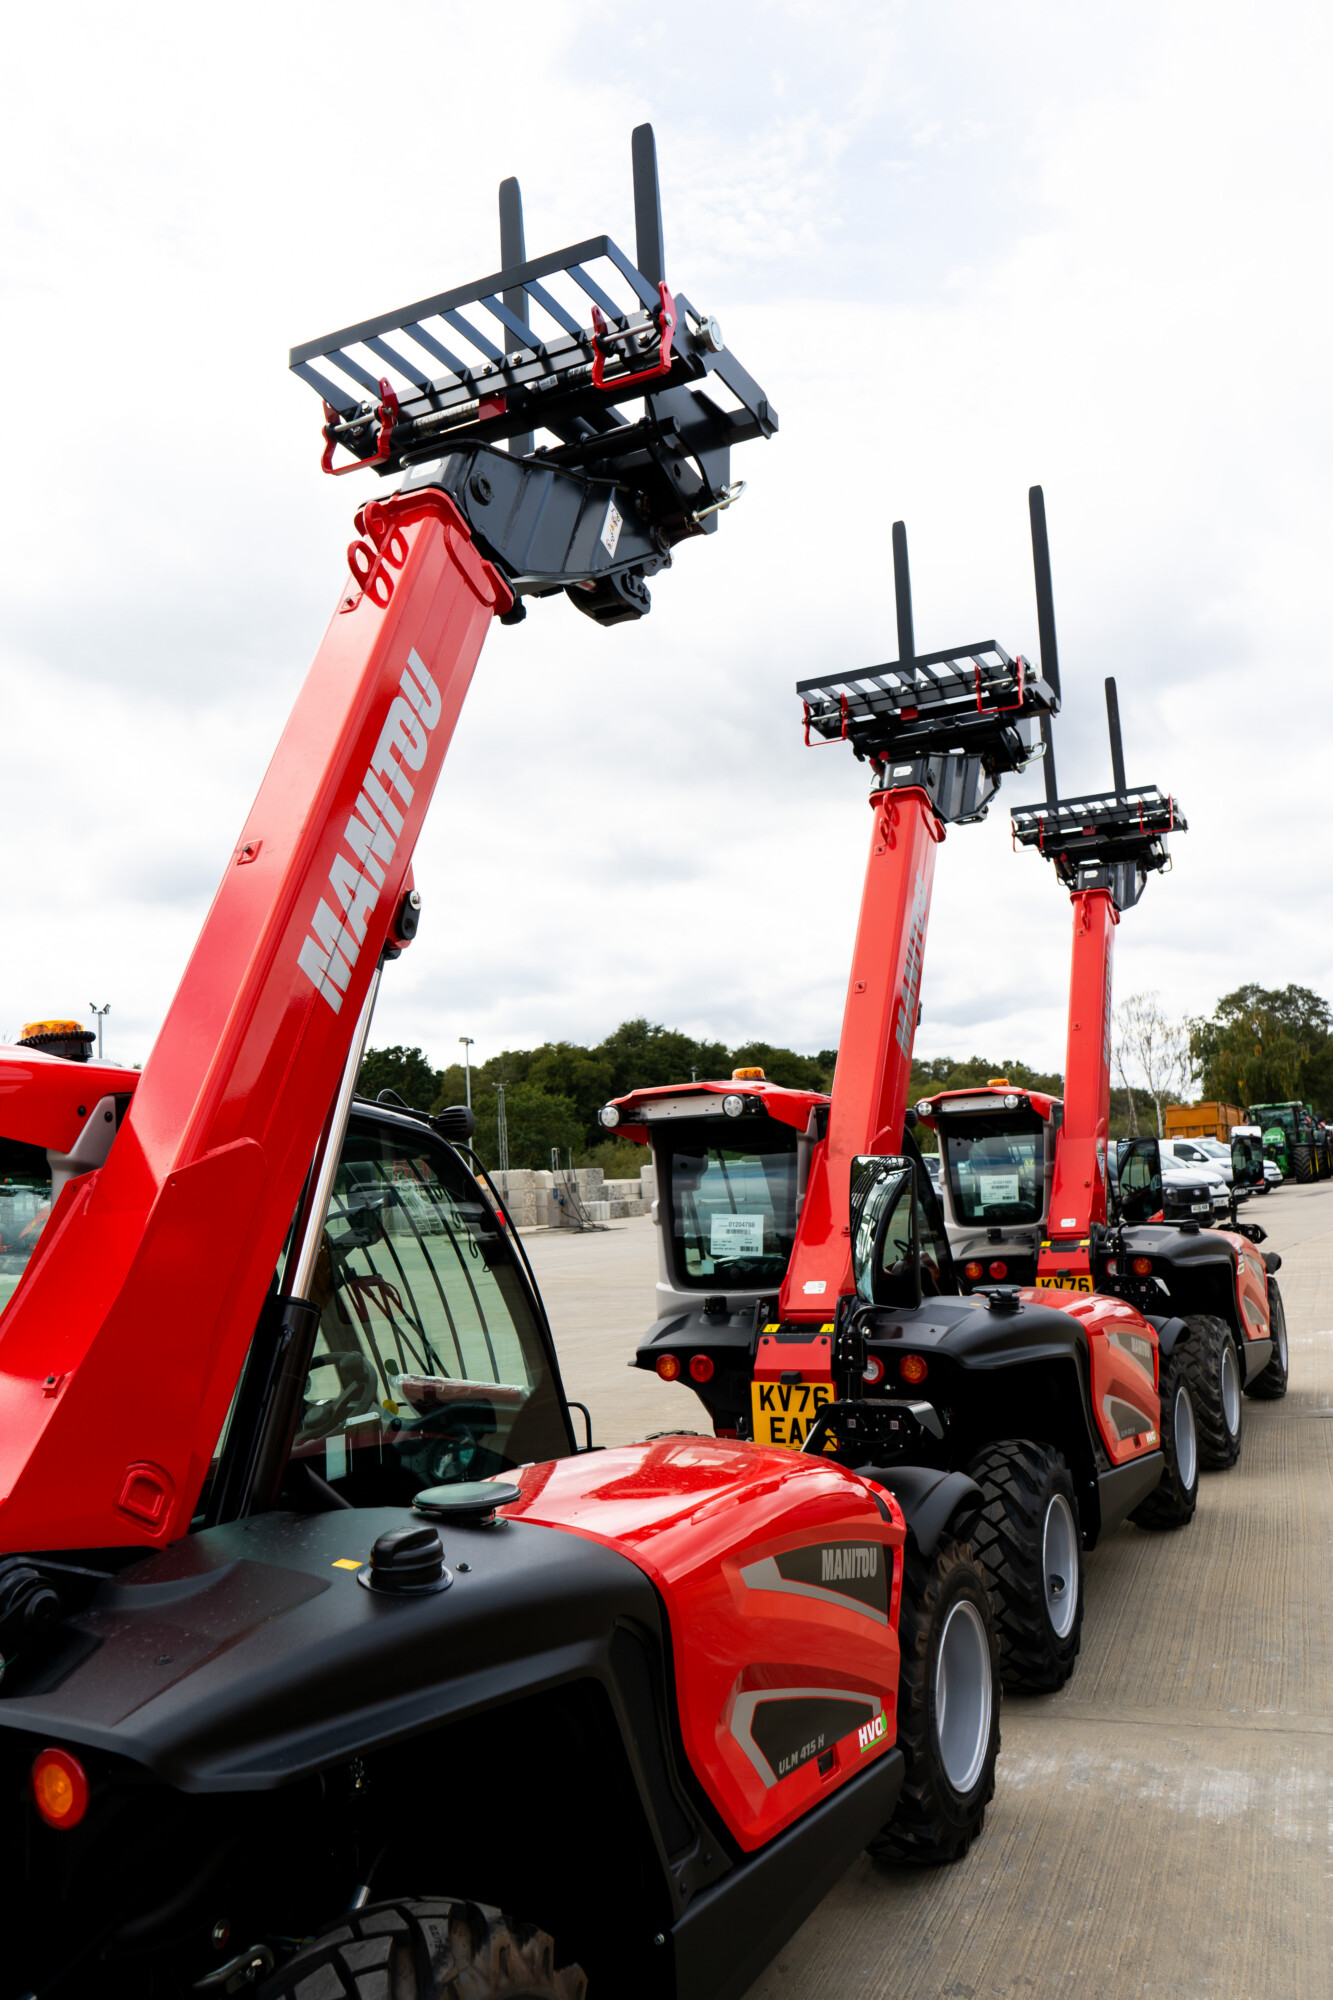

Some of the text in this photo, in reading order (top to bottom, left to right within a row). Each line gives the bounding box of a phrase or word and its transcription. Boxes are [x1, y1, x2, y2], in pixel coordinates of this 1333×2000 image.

[297, 647, 442, 1015] MANITOU
[759, 1385, 829, 1412] KV76
[822, 1547, 878, 1581] MANITOU
[778, 1733, 825, 1774] ULM 415 H
